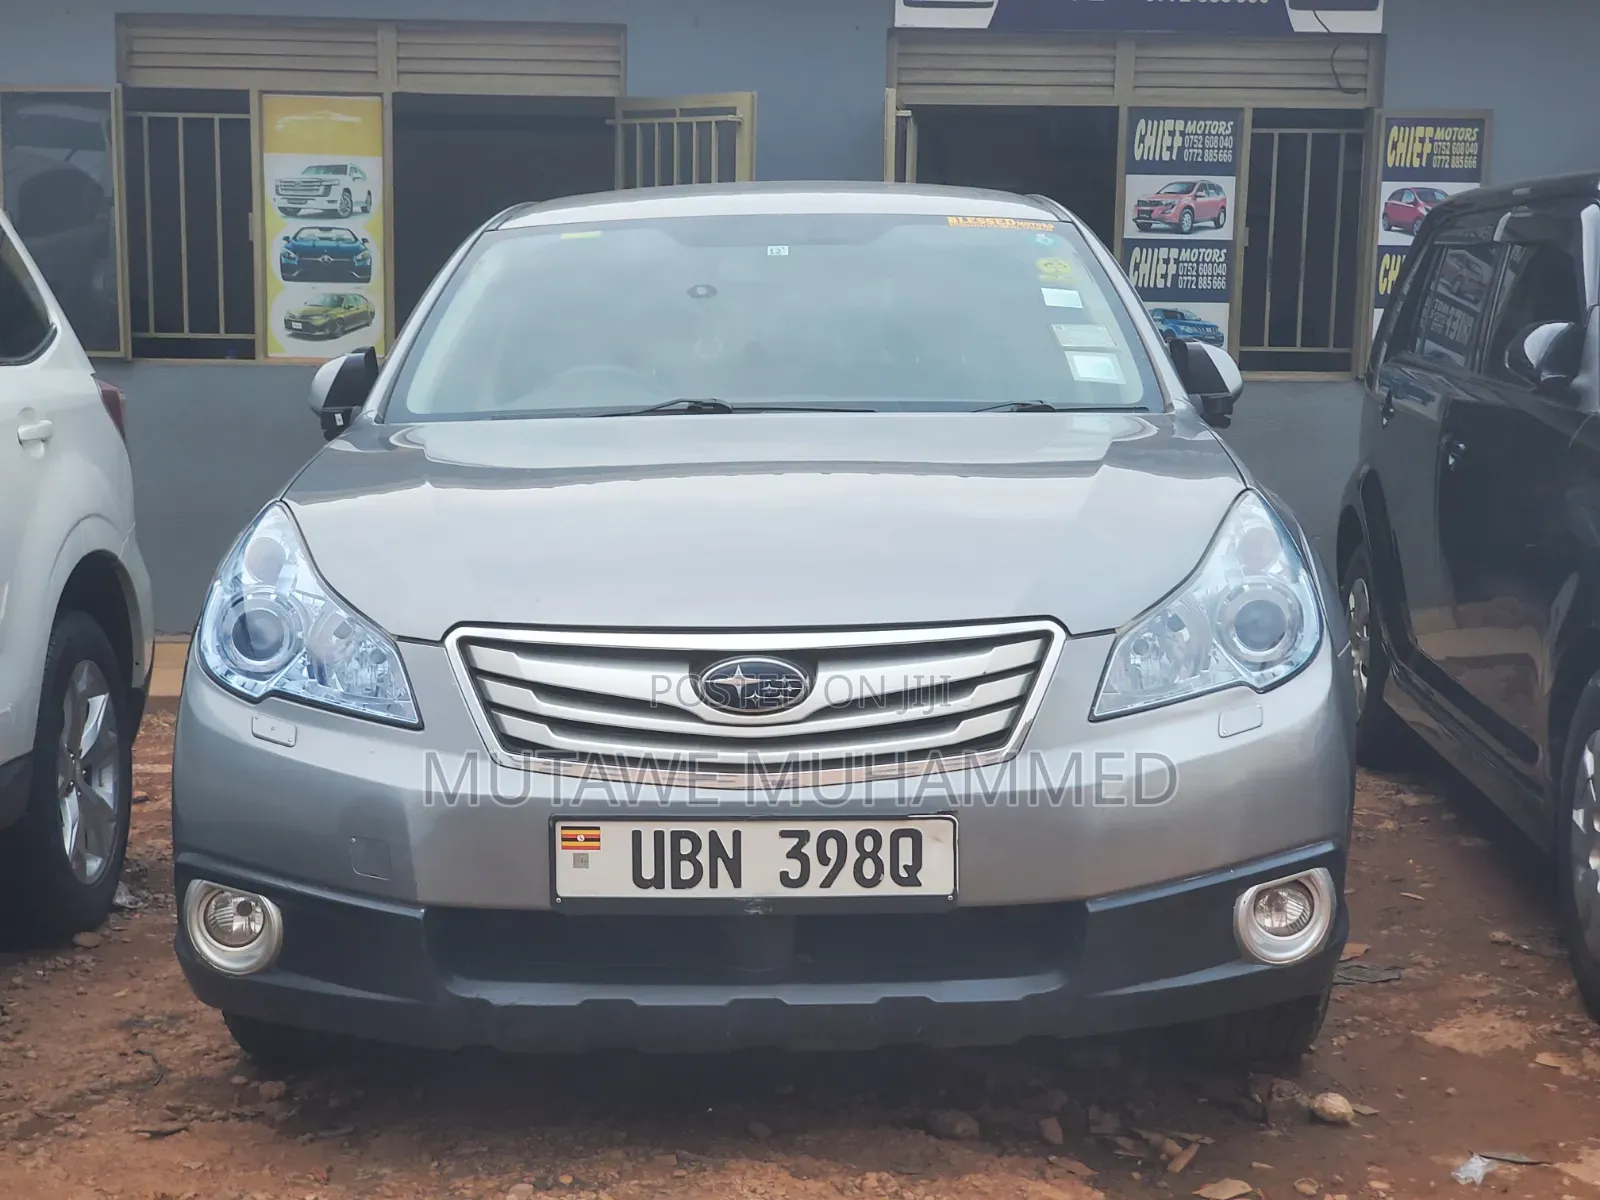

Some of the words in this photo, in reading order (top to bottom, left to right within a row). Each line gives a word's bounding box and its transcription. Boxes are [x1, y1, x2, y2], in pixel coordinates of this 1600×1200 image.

[1185, 120, 1234, 135] MOTORS
[1434, 127, 1479, 142] MOTORS
[1134, 118, 1185, 161] CHIEF
[1184, 135, 1203, 148] 0752
[1204, 135, 1219, 149] 608
[1220, 136, 1233, 149] 040
[1387, 125, 1434, 168] CHIEF
[1183, 148, 1203, 162] 0772
[1203, 149, 1218, 162] 885
[1218, 149, 1233, 162] 666
[1433, 141, 1451, 155] 0752
[1465, 142, 1478, 156] 040
[1432, 155, 1450, 169] 0772
[1464, 156, 1477, 169] 666
[1179, 248, 1228, 263] MOTORS
[1129, 246, 1179, 289] CHIEF
[1178, 262, 1197, 276] 0752
[1198, 262, 1212, 276] 608
[1212, 262, 1227, 276] 040
[1178, 276, 1197, 289] 0772
[1197, 276, 1212, 290] 885
[1212, 276, 1226, 290] 666
[631, 829, 742, 890] UBN
[778, 828, 923, 889] 398Q
